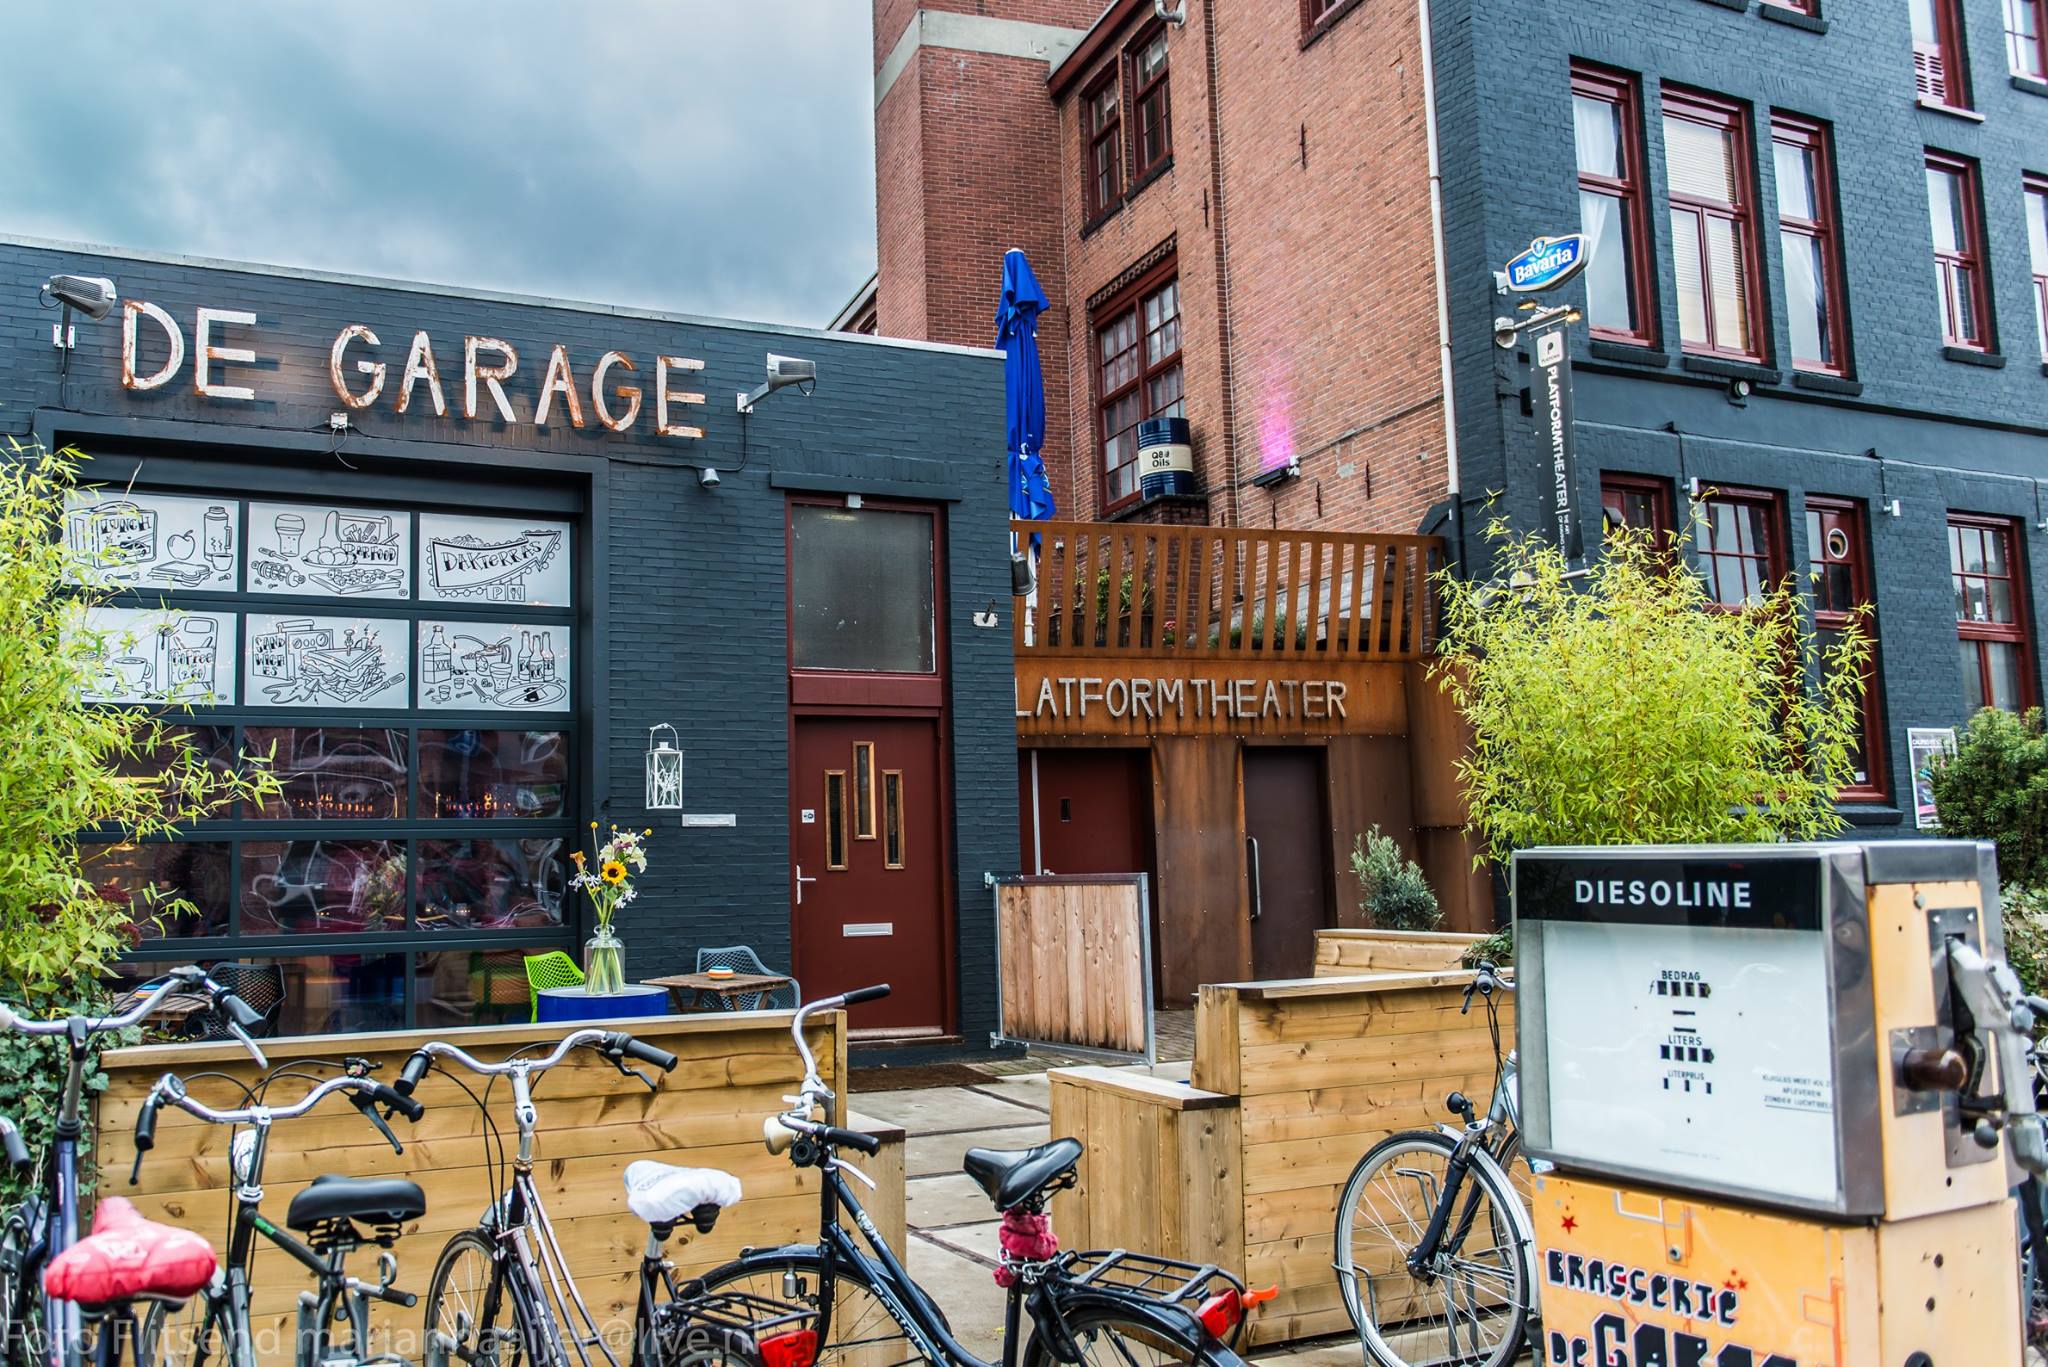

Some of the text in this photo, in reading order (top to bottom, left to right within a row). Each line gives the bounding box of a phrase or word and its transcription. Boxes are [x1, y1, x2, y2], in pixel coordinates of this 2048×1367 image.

[1514, 248, 1573, 284] Bavaria
[122, 300, 705, 438] DE GARAGE
[1547, 366, 1569, 509] PLATFORMTHEATER
[1152, 459, 1170, 467] Oils
[101, 515, 152, 534] LUNCH
[255, 636, 285, 653] SAND
[255, 653, 285, 667] WICH
[263, 666, 278, 676] ES
[1575, 880, 1752, 908] DIESOLINE
[1661, 970, 1701, 981] BEDRAG
[1668, 1035, 1703, 1046] LITERS
